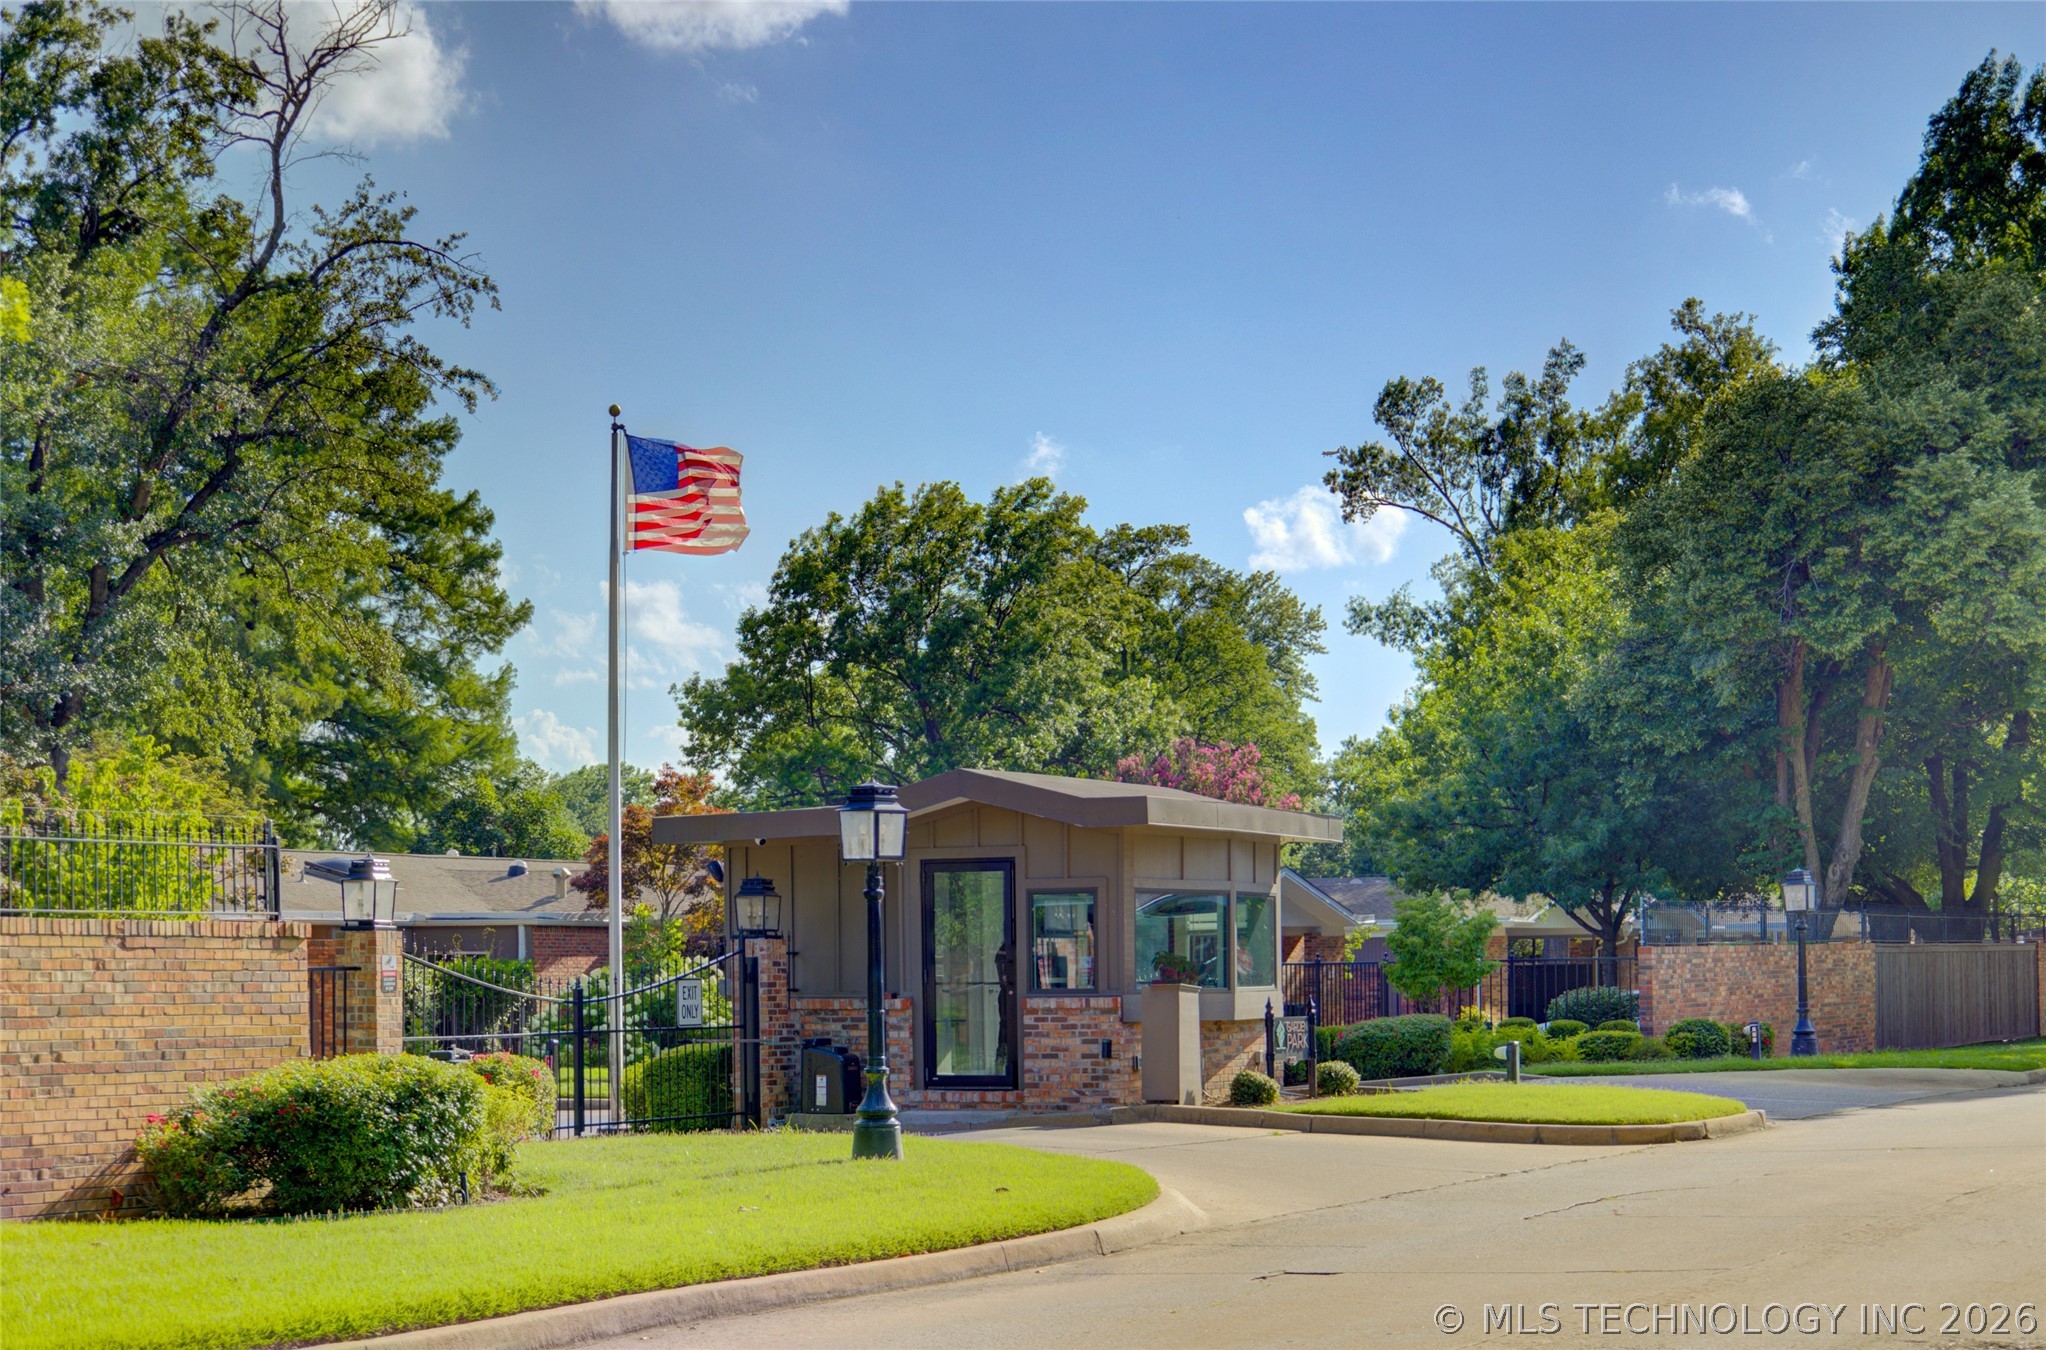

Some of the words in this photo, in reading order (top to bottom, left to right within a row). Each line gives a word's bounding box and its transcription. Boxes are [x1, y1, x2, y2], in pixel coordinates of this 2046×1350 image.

[682, 985, 698, 1001] EXIT
[681, 1004, 700, 1019] ONLY
[1287, 1033, 1309, 1049] PARK
